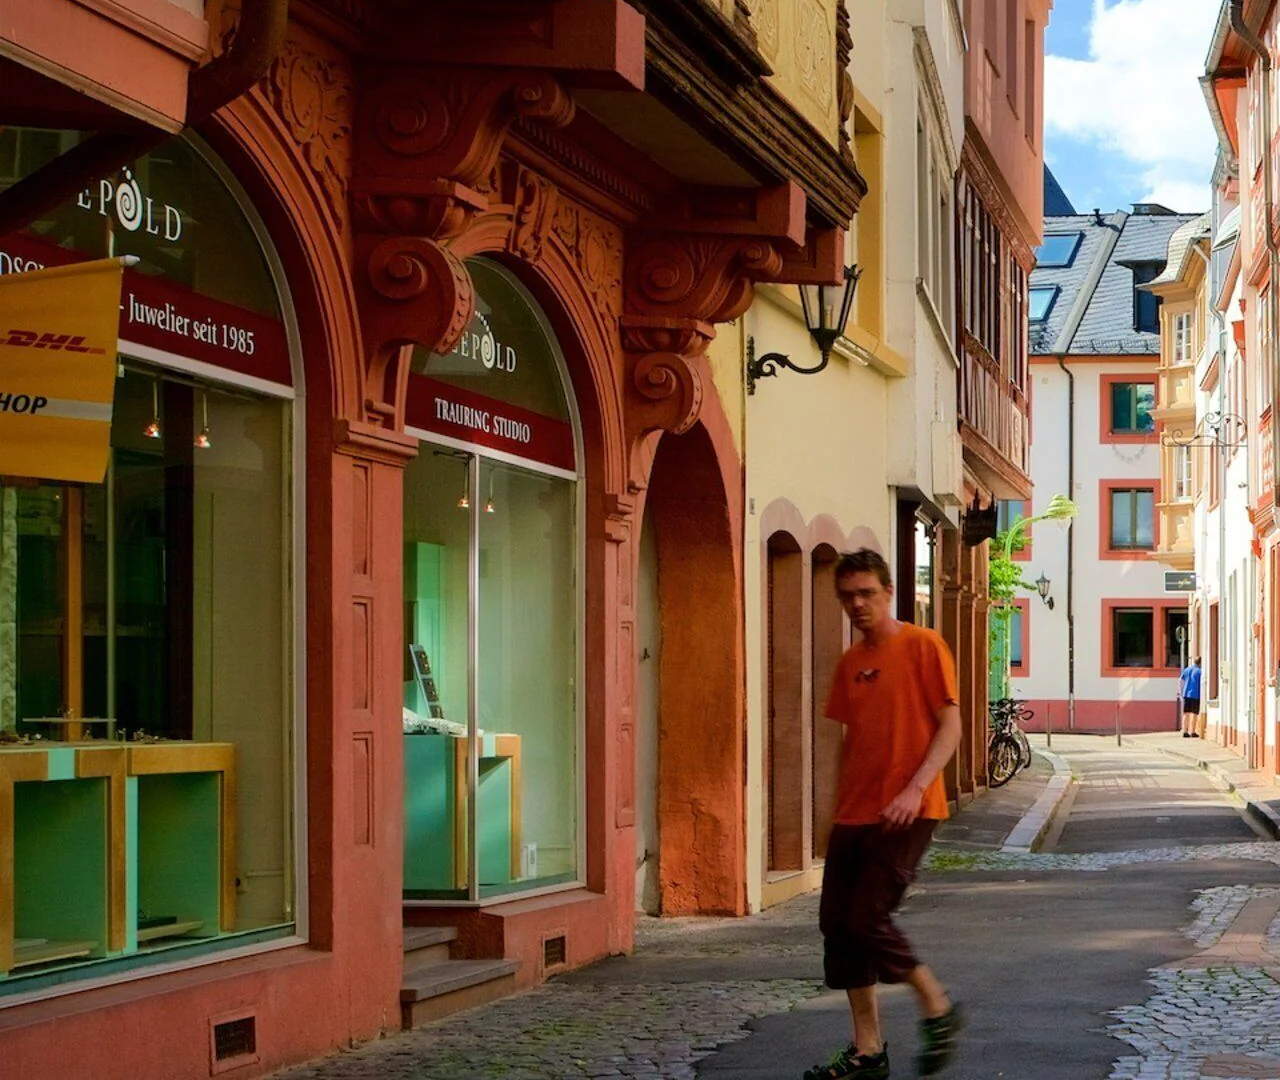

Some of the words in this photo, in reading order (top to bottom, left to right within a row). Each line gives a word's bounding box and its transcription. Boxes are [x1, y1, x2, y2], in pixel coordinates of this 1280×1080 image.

[6, 329, 90, 353] DHL
[128, 293, 190, 337] Juwelier
[193, 318, 218, 345] seit
[222, 324, 255, 356] 1985
[0, 392, 48, 414] HOP
[435, 397, 490, 433] TRAURING
[493, 415, 531, 443] STUDIO
